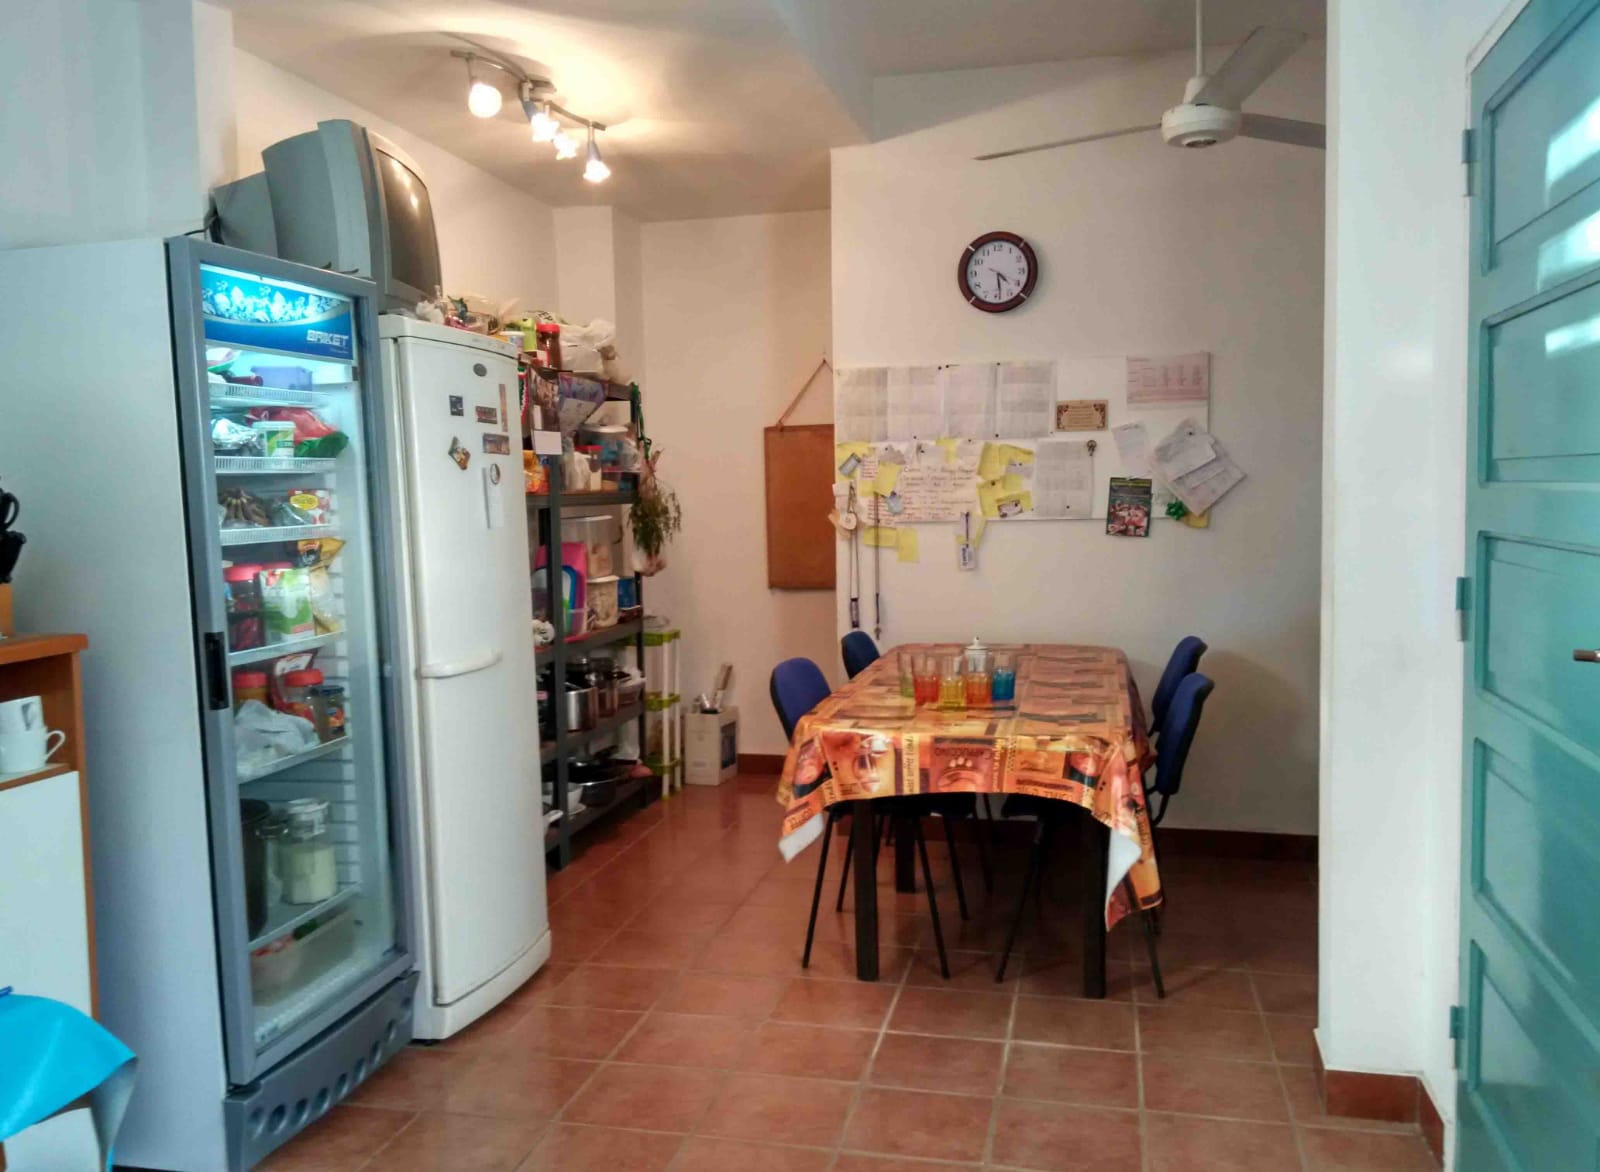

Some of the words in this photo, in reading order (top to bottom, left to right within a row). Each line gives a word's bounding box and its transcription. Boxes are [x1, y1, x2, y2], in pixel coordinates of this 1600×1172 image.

[993, 244, 1003, 252] 12
[982, 249, 990, 257] 11
[974, 258, 984, 266] 10
